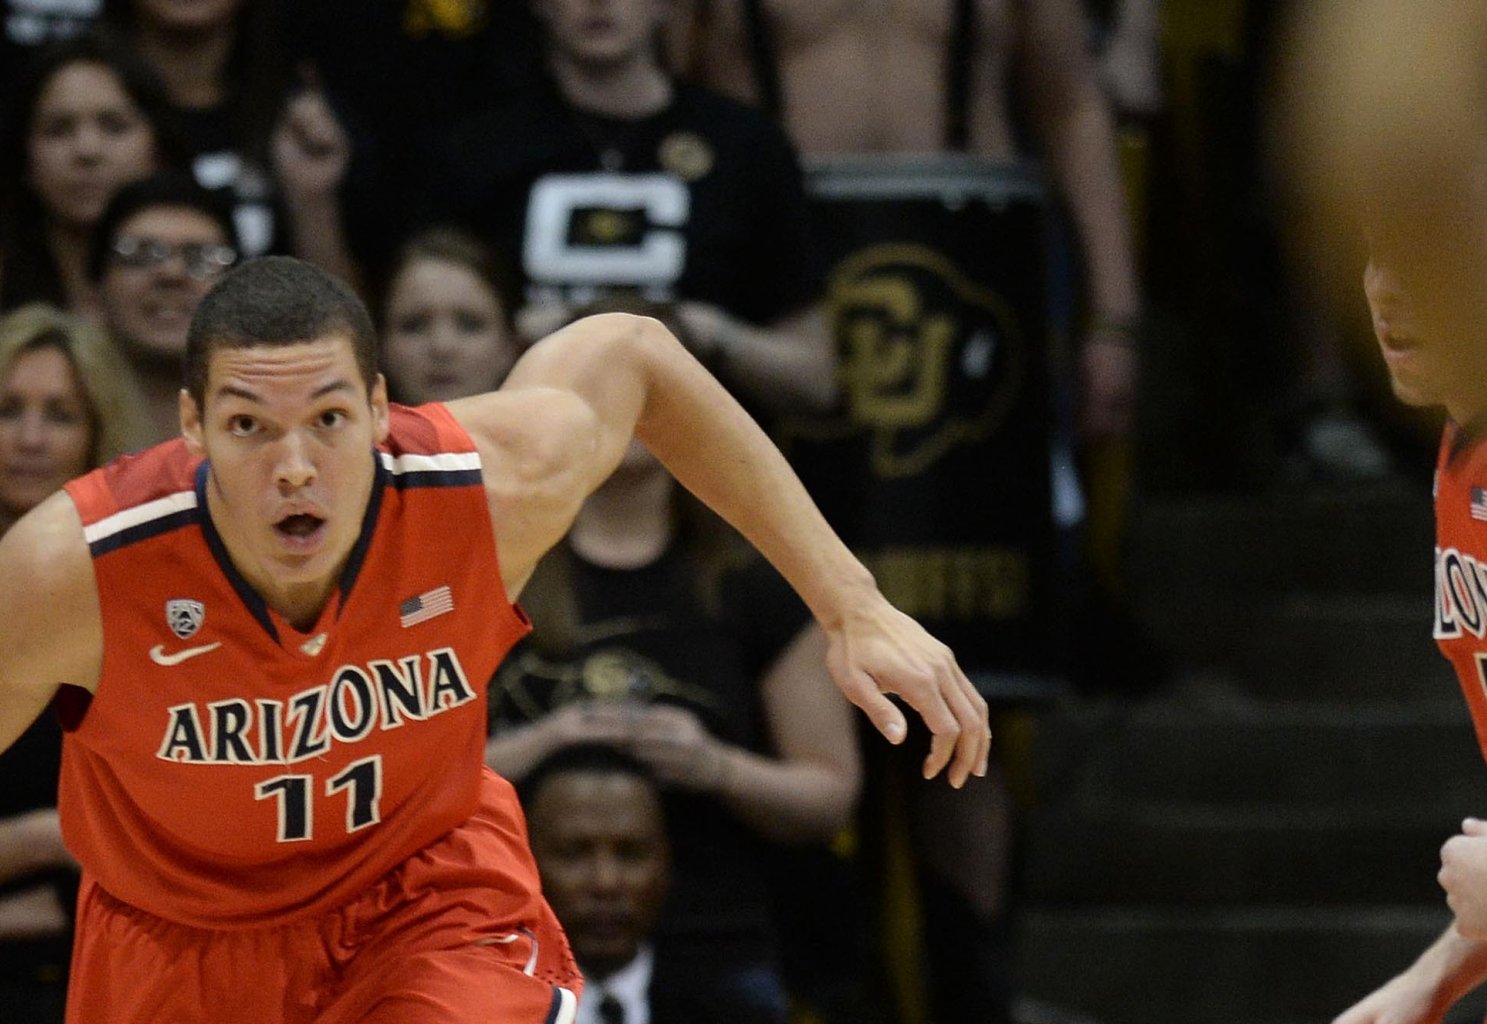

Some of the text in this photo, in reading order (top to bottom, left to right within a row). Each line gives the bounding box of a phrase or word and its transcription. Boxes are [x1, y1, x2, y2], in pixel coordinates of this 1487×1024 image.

[522, 171, 690, 284] C
[156, 647, 477, 765] ARIZONA
[255, 754, 383, 843] 11
